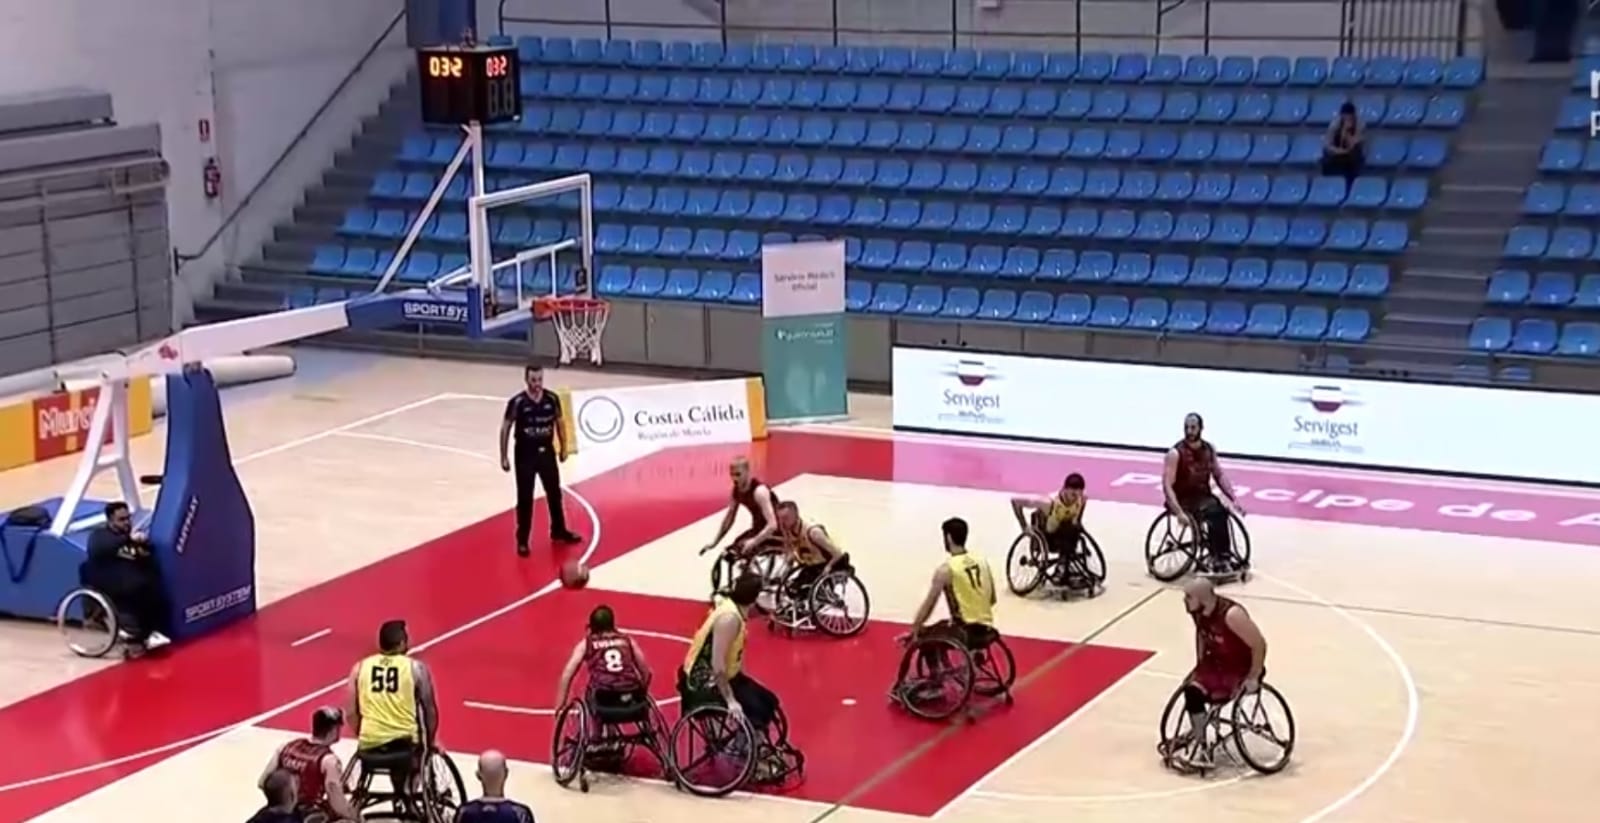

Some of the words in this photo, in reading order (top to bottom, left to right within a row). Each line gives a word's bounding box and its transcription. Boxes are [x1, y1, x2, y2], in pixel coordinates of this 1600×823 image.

[943, 388, 1000, 411] Servigest
[634, 410, 684, 426] Costa
[688, 404, 745, 423] Cálida
[1293, 416, 1359, 439] Servigest
[1437, 502, 1537, 522] de
[965, 564, 982, 590] 17
[604, 648, 624, 672] 8
[371, 666, 399, 693] 59
